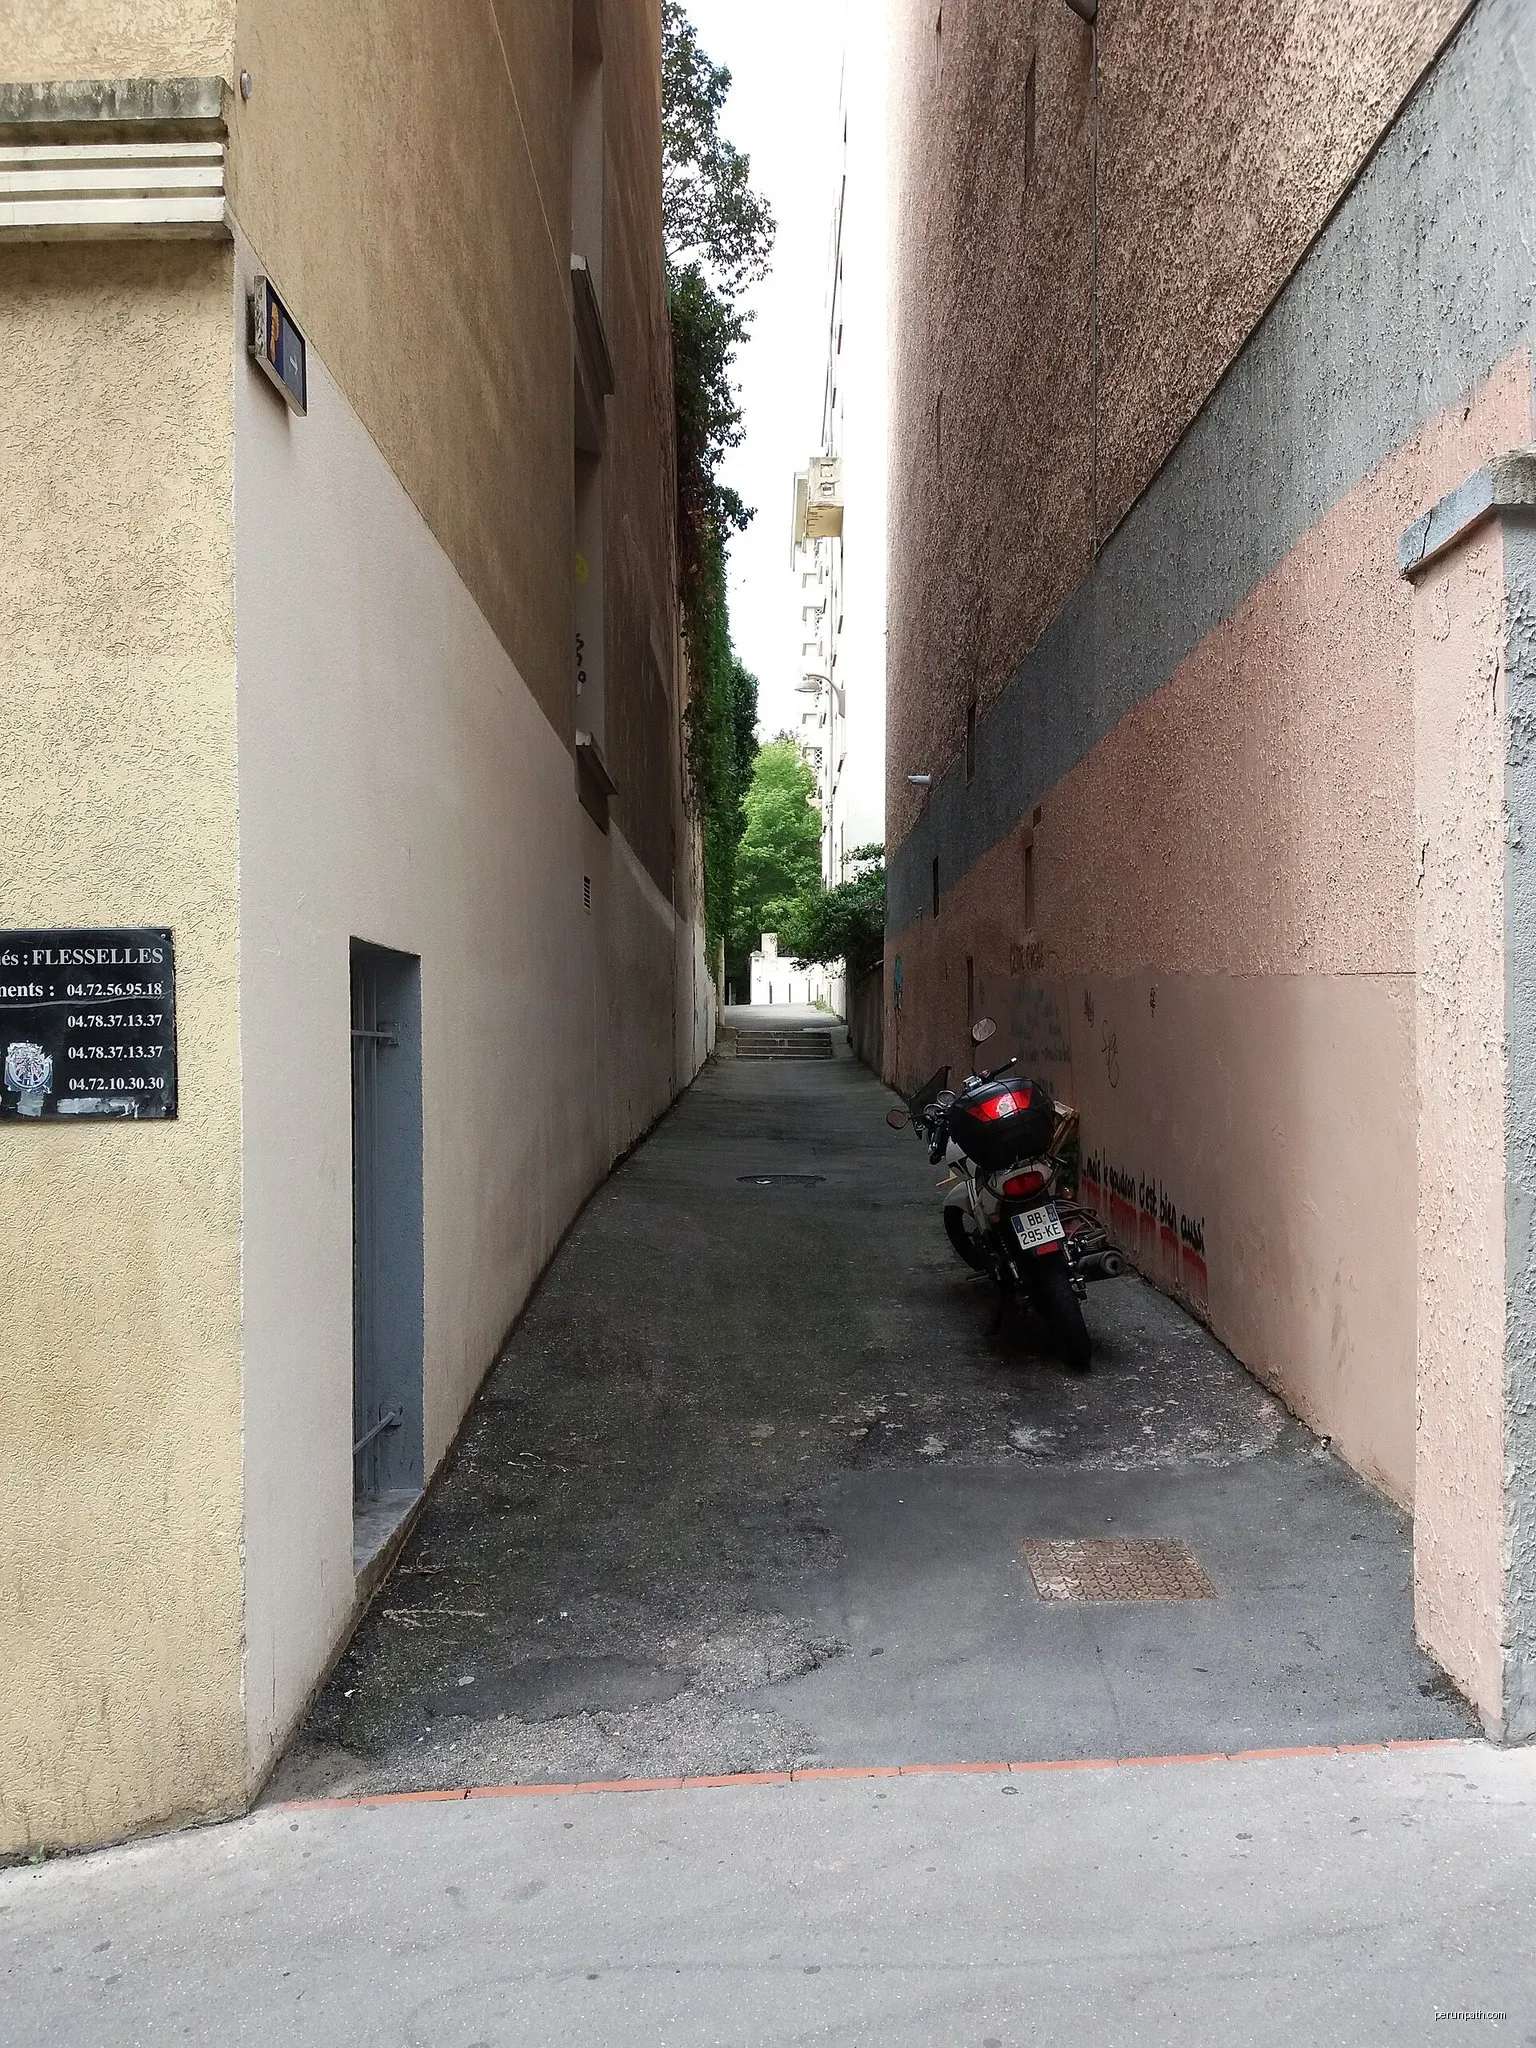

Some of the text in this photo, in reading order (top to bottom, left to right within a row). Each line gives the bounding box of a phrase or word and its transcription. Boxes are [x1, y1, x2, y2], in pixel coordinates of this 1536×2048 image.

[0, 949, 19, 966] és
[66, 982, 163, 997] 04.72.56.95.18
[67, 1014, 163, 1028] 04.78.37.13.37
[67, 1046, 163, 1060] 04.78.37.13.37
[68, 1077, 164, 1091] 04.72.10.30.30
[1159, 1179, 1178, 1234] bien
[1180, 1213, 1205, 1257] aussi
[1020, 1223, 1061, 1245] 295-KE
